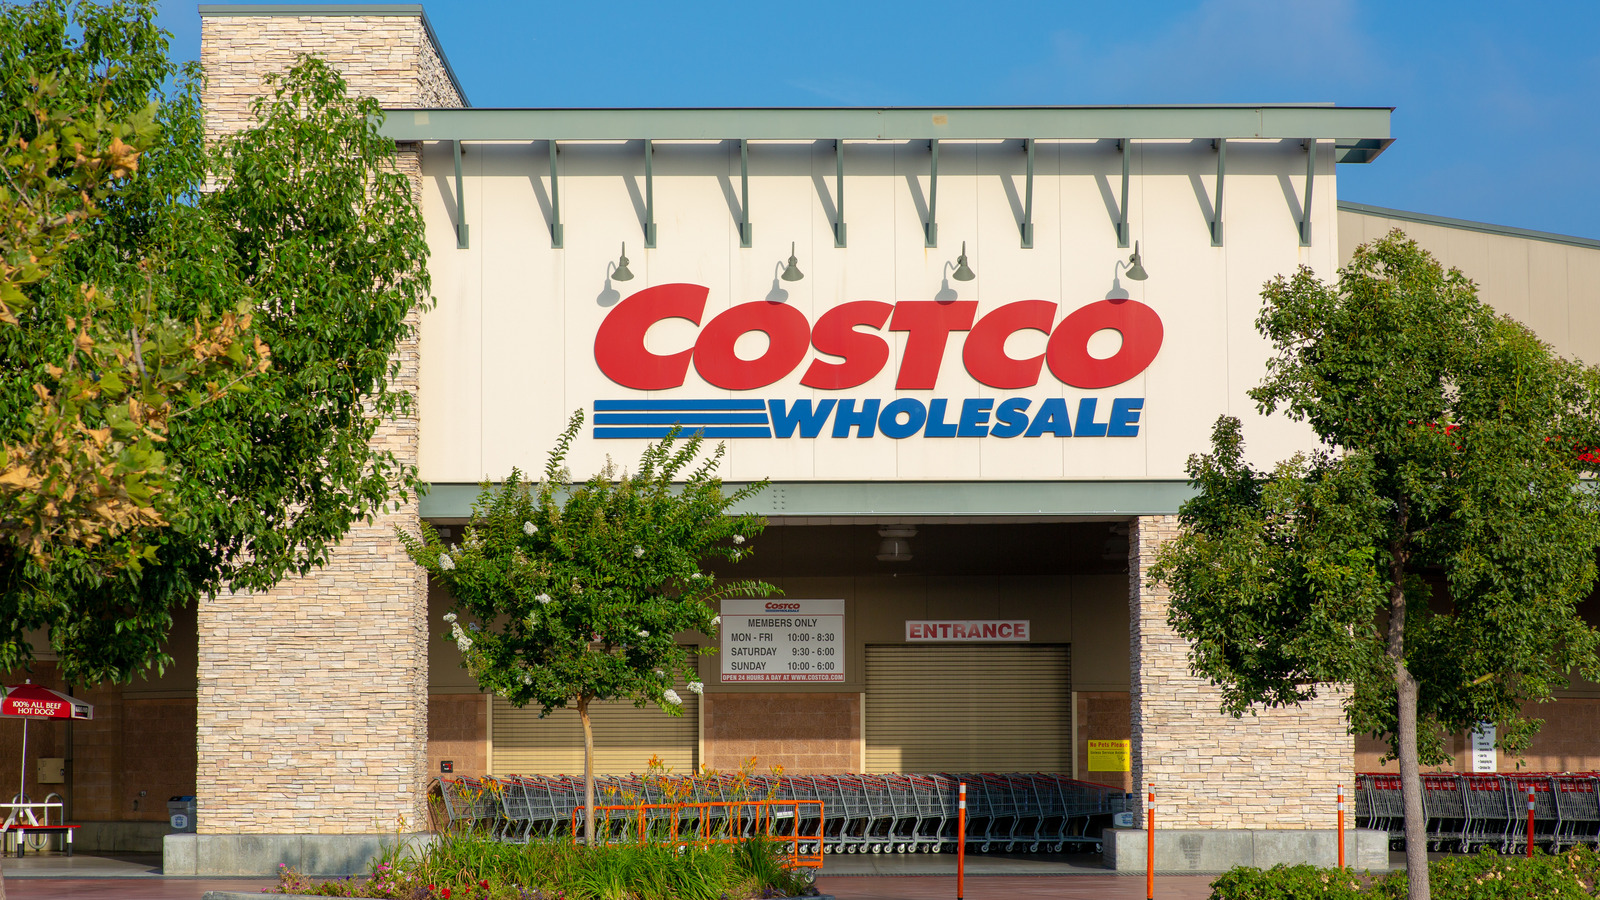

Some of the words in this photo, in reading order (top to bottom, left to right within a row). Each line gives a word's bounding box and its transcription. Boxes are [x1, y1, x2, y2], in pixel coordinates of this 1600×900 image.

[594, 283, 1164, 390] COSTCO
[768, 397, 1145, 439] WHOLESALE
[748, 618, 792, 628] MEMBERS
[794, 618, 817, 628] ONLY
[909, 623, 1026, 639] ENTRANCE
[731, 633, 751, 642] MON
[759, 633, 773, 642] FRI
[788, 633, 810, 642] 10:00
[817, 633, 835, 642] 8:30
[731, 647, 777, 656] SATURDAY
[792, 647, 810, 656] 9:30
[817, 647, 835, 656] 6:00
[731, 661, 767, 671] SUNDAY
[788, 661, 810, 671] 10:00
[817, 661, 835, 671] 6:00
[46, 702, 62, 710] BEEF
[34, 708, 55, 716] DOGS
